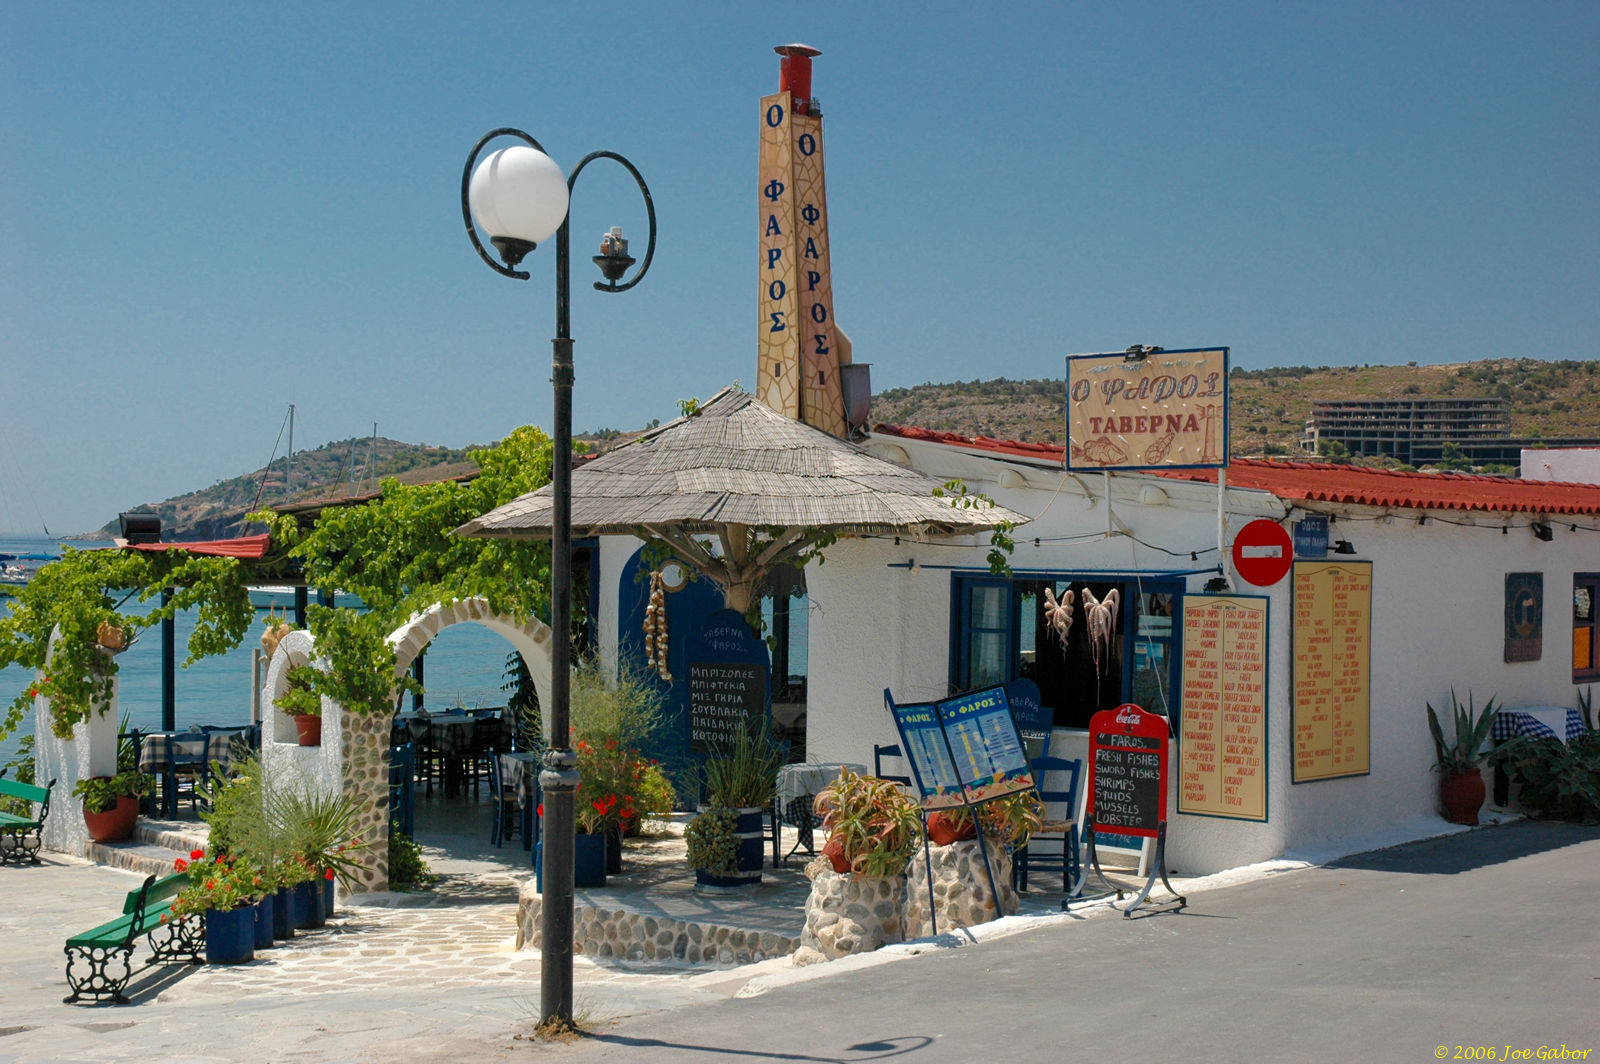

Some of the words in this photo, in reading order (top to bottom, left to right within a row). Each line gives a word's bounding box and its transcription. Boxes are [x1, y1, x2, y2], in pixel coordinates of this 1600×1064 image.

[764, 179, 786, 333] ΦΑΡΟΣ
[801, 203, 830, 356] ΦΑΡΟΣ
[1089, 413, 1200, 434] ΤΑΒΕΡΝΑ
[1096, 749, 1122, 763] FRESH
[1127, 752, 1159, 766] FISHES
[1095, 763, 1126, 775] SWORD
[1130, 767, 1160, 780] FISHES
[1095, 775, 1136, 791] SHRIMPS
[1095, 801, 1140, 815] MUSSELS
[1096, 811, 1143, 826] LOBSTER
